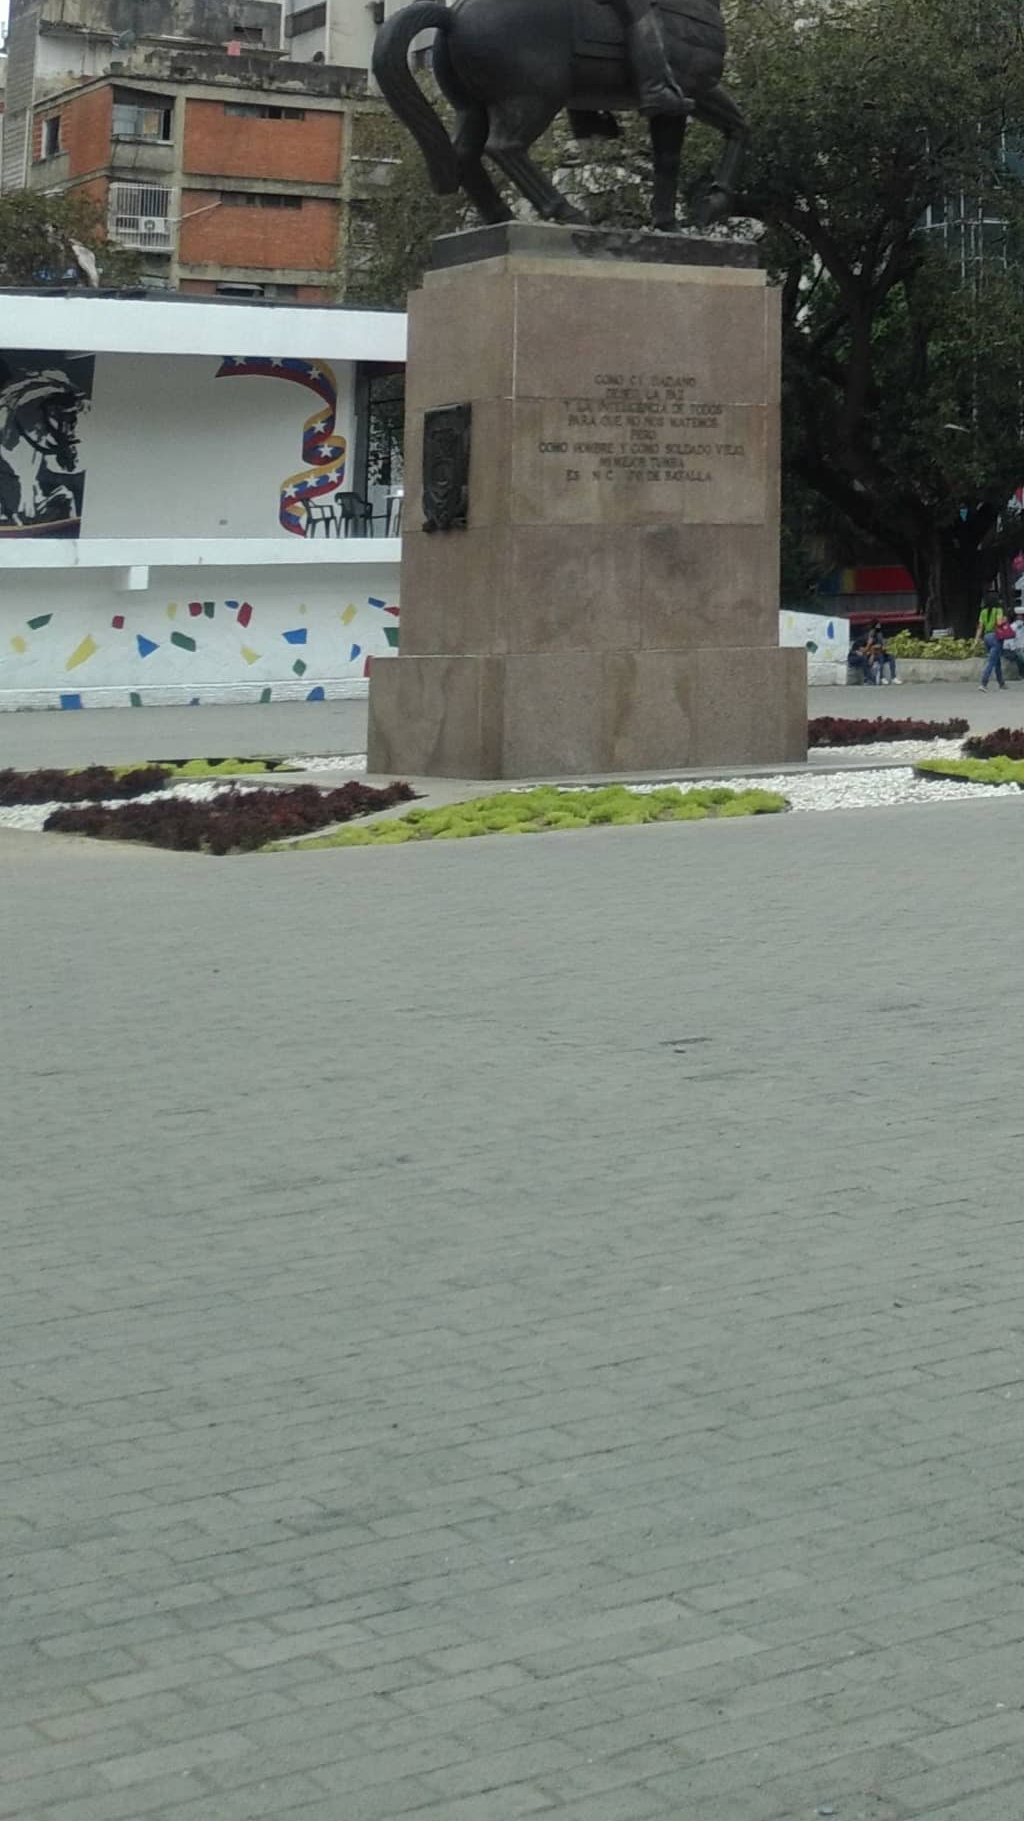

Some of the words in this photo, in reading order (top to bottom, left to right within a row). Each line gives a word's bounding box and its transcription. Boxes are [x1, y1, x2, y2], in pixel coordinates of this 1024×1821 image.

[594, 374, 624, 385] COMO
[630, 375, 697, 387] CIDADANO
[568, 414, 596, 427] PARA
[600, 416, 623, 427] QUE
[670, 417, 719, 429] MATEMOS
[538, 442, 568, 454] COMO
[574, 442, 614, 454] HOMBRE
[631, 443, 659, 455] COMO
[665, 444, 712, 455] SOLDADO
[566, 469, 580, 481] ES
[647, 471, 660, 482] DE
[664, 471, 712, 482] BATALLA
